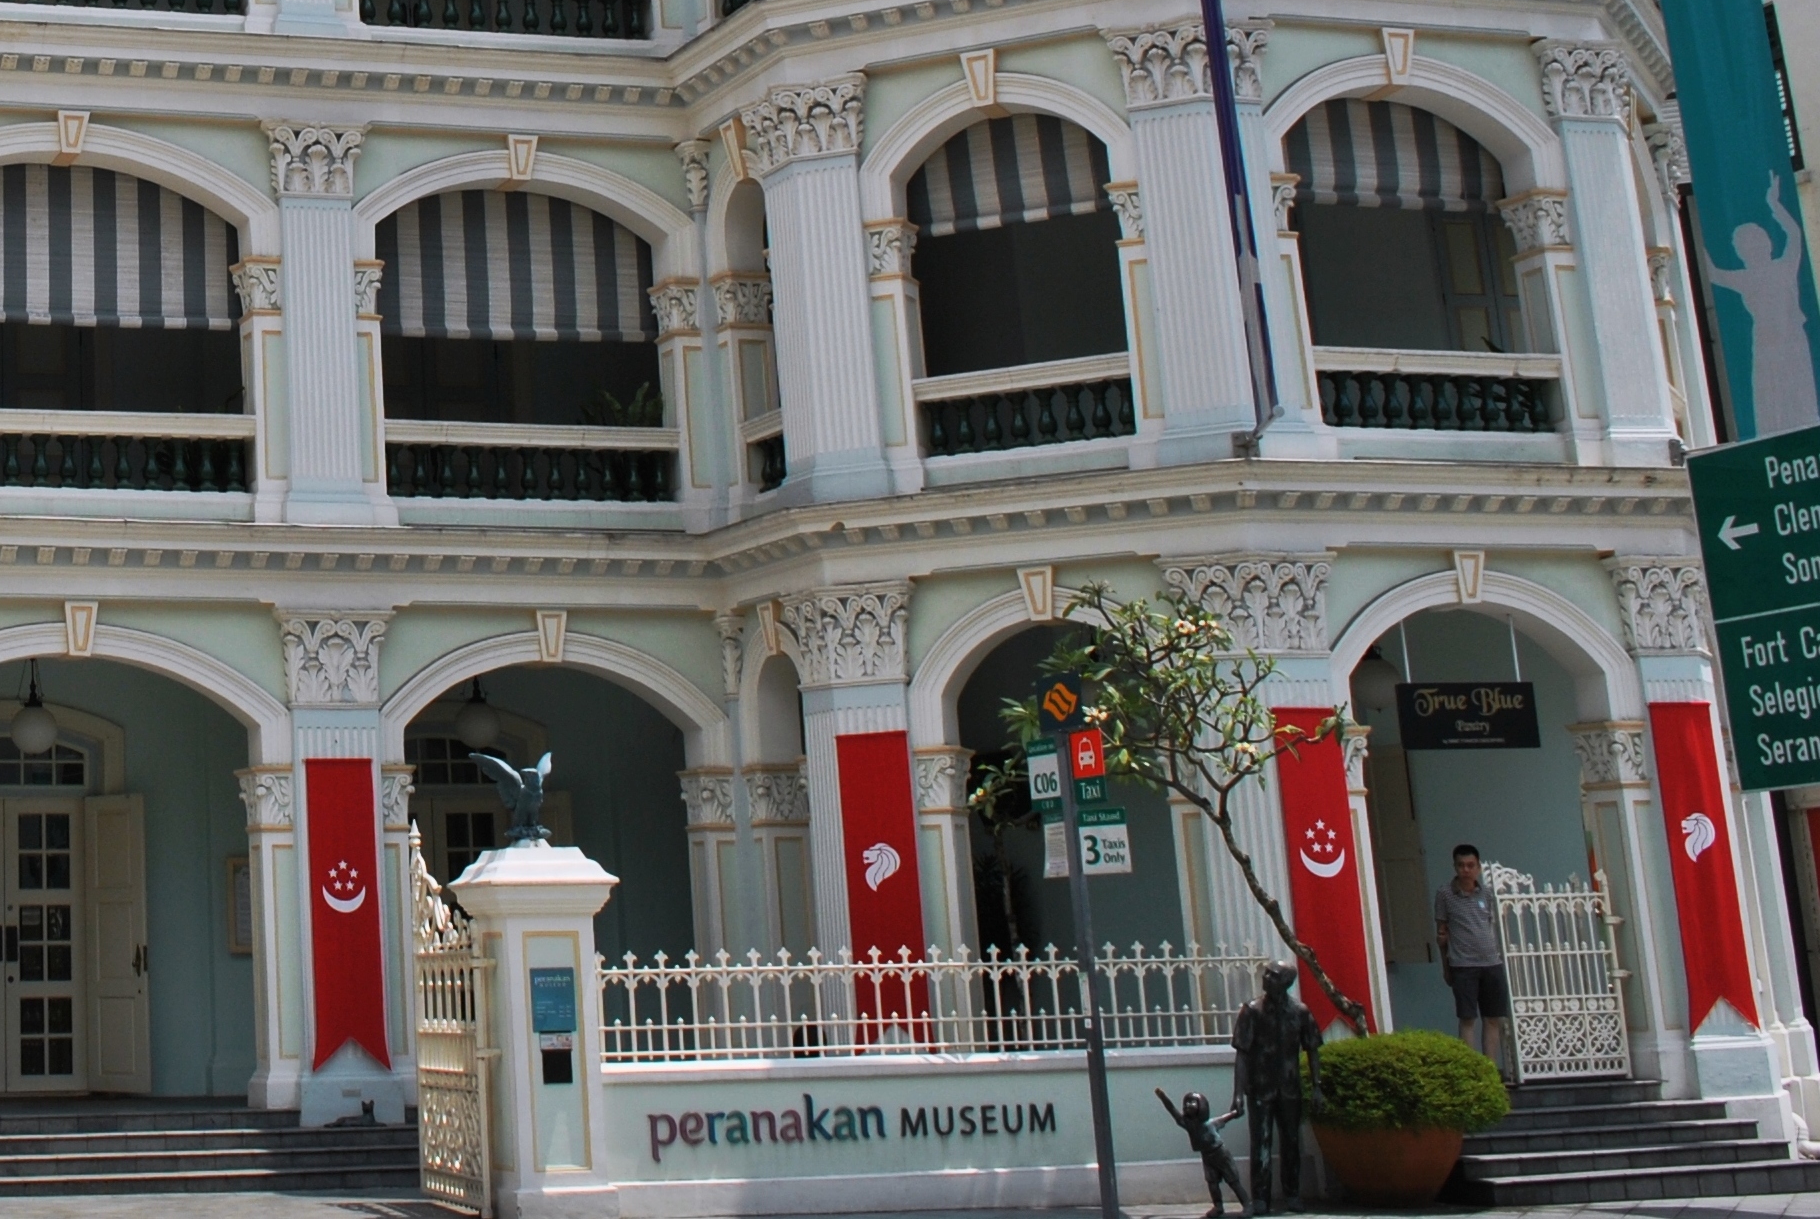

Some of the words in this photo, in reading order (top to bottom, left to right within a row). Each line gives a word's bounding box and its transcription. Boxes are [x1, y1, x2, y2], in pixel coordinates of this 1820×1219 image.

[1765, 453, 1820, 488] Pena
[1741, 631, 1789, 668] Fort
[1800, 626, 1820, 659] C
[1413, 688, 1468, 717] True
[1471, 687, 1524, 716] Blue
[1749, 676, 1820, 719] Selegi
[1034, 771, 1058, 794] C06
[1080, 780, 1101, 799] Taxi
[1083, 813, 1097, 822] Taxi
[1083, 834, 1101, 866] 3
[1101, 837, 1126, 850] Taxis
[1103, 851, 1125, 864] Only
[647, 1093, 887, 1163] peranakan
[900, 1102, 1057, 1138] MUSEUM
